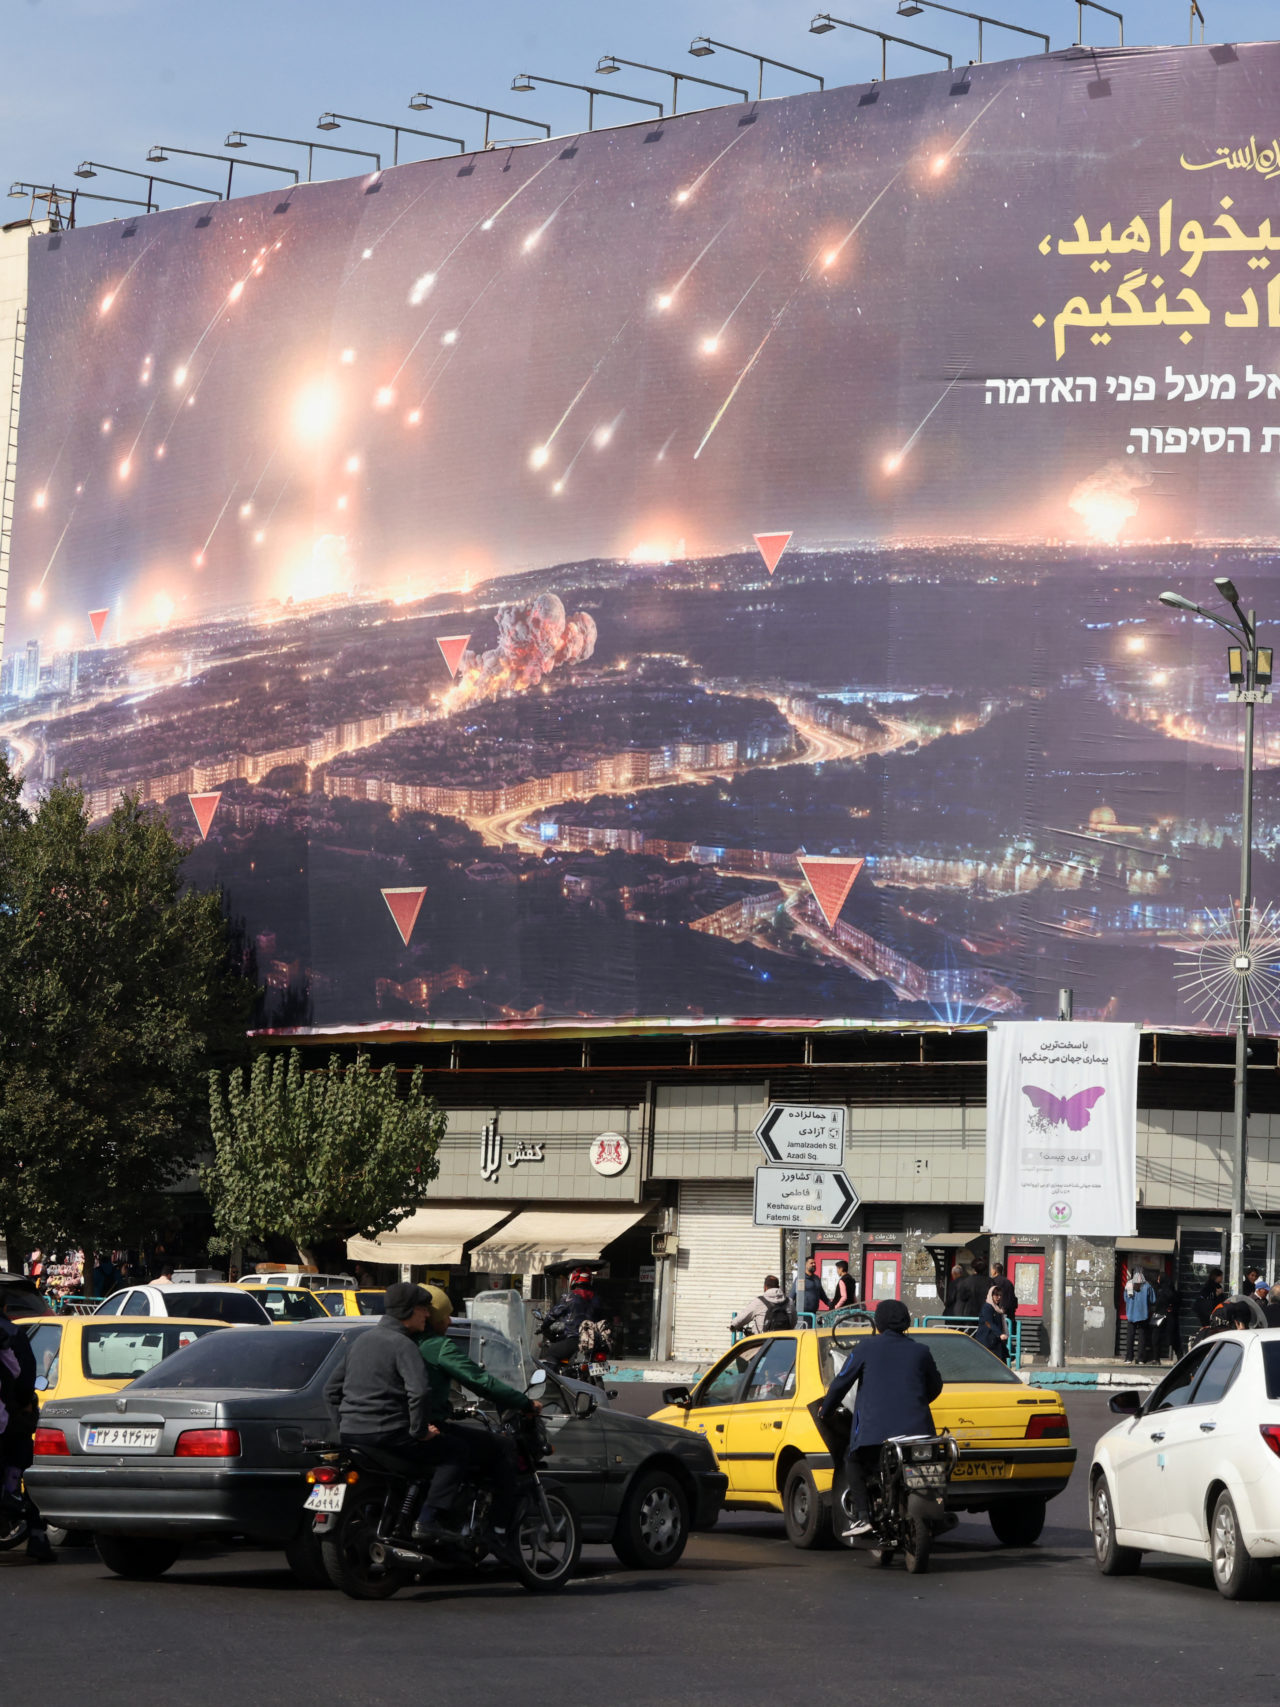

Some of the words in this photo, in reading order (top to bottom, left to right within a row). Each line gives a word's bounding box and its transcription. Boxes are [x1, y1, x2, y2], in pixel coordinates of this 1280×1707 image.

[1179, 135, 1257, 171] است
[1032, 267, 1211, 361] جنگیم.
[1107, 373, 1157, 402] פני
[1166, 366, 1237, 401] מעל
[984, 374, 1098, 405] האדמה
[1125, 424, 1251, 455] הסיפור.
[1061, 1053, 1082, 1064] جهان
[1082, 1054, 1109, 1065] بیماری
[788, 1110, 827, 1121] جمالزاده
[798, 1127, 827, 1138] آزادی
[787, 1141, 828, 1150] Jamalzadeh
[506, 1141, 543, 1166] کفش
[786, 1152, 806, 1160] Azadi
[780, 1172, 812, 1183] کشاورز
[781, 1188, 811, 1199] فاطمی
[766, 1202, 804, 1212] Keshavarz
[805, 1204, 824, 1212] Blvd.
[766, 1213, 791, 1221] Fatemi
[307, 1498, 340, 1510] ۸۵۹۹۸
